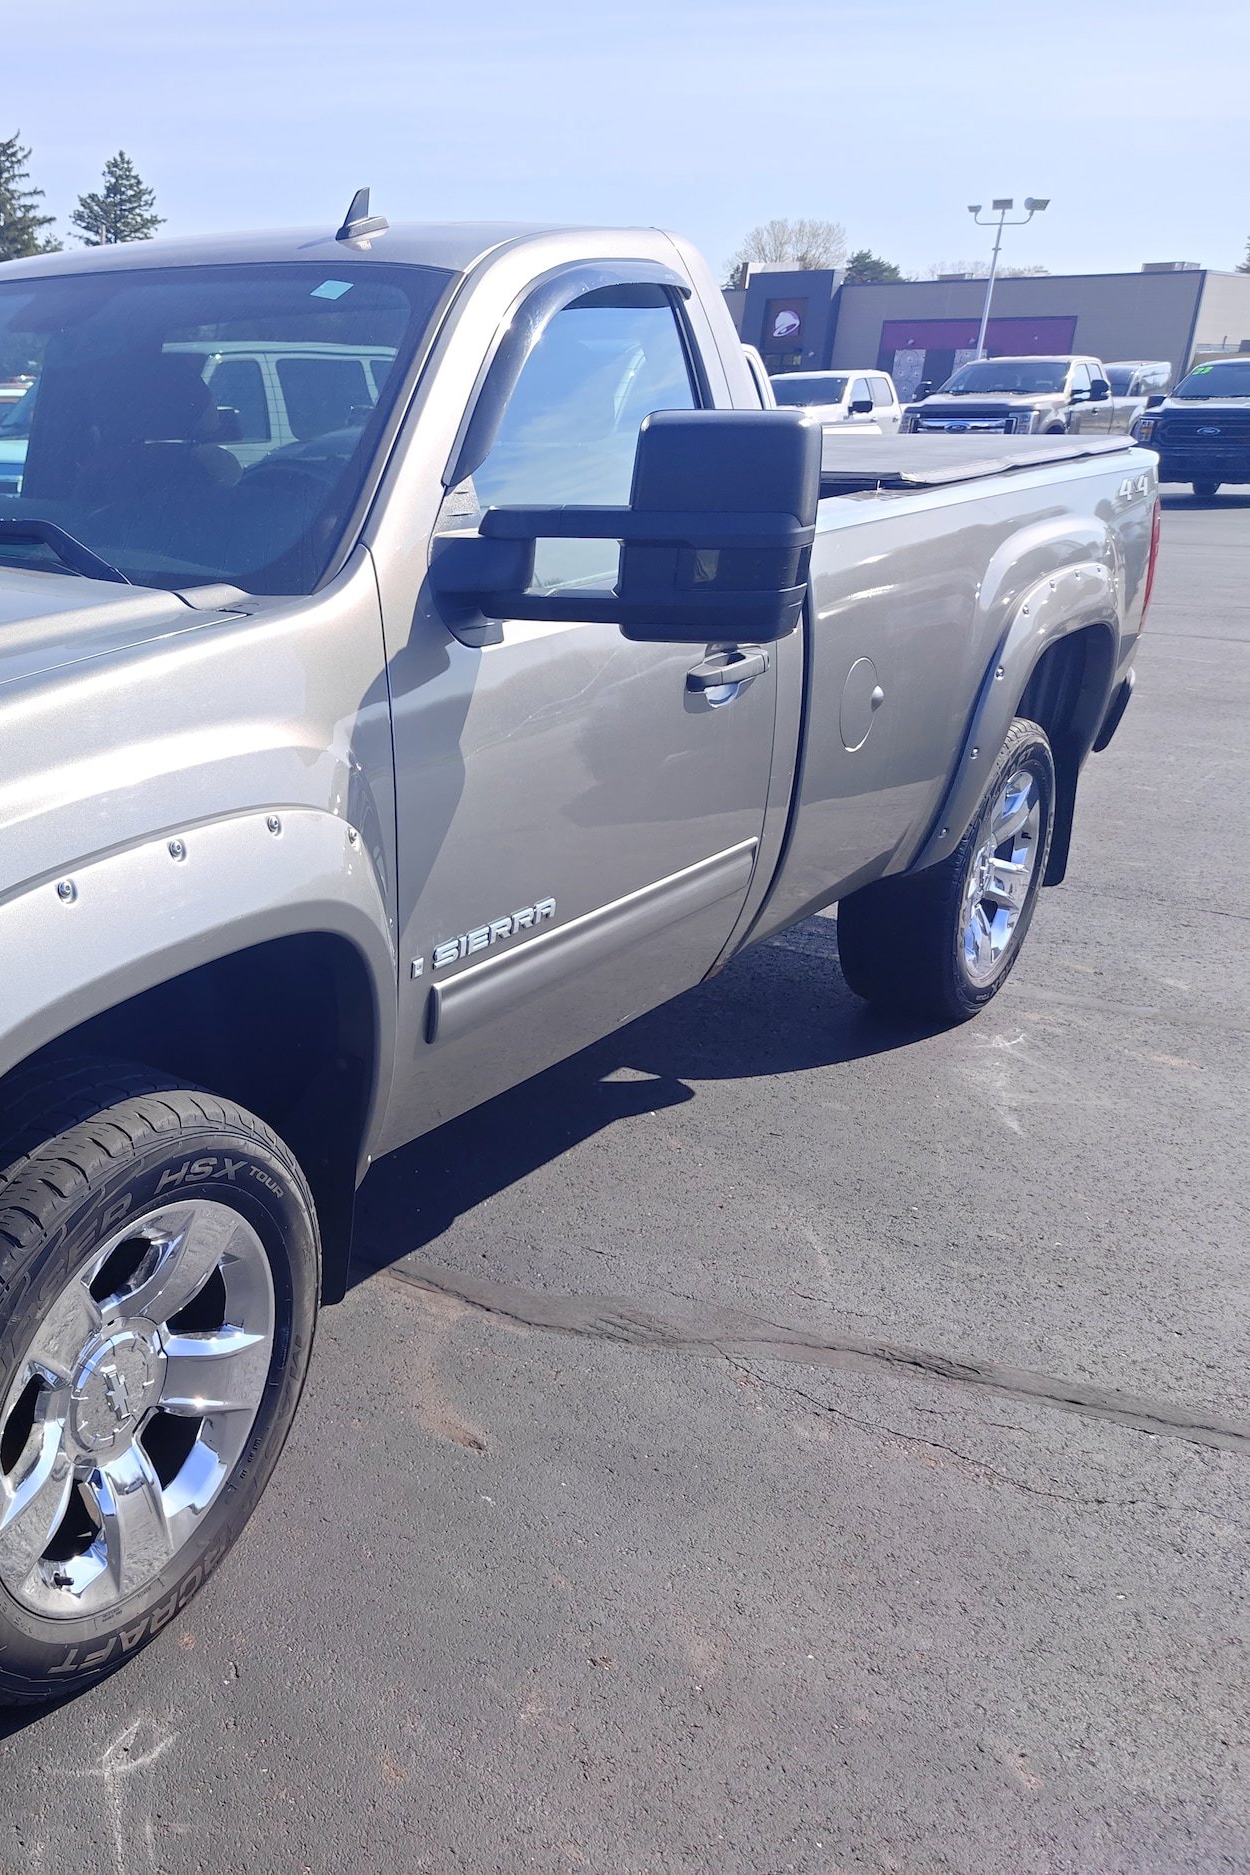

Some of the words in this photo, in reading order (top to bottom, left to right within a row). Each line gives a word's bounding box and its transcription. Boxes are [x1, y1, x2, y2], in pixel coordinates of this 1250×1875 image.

[432, 897, 556, 969] SIERRA
[153, 1157, 248, 1195] HSX
[249, 1165, 284, 1199] TOUR
